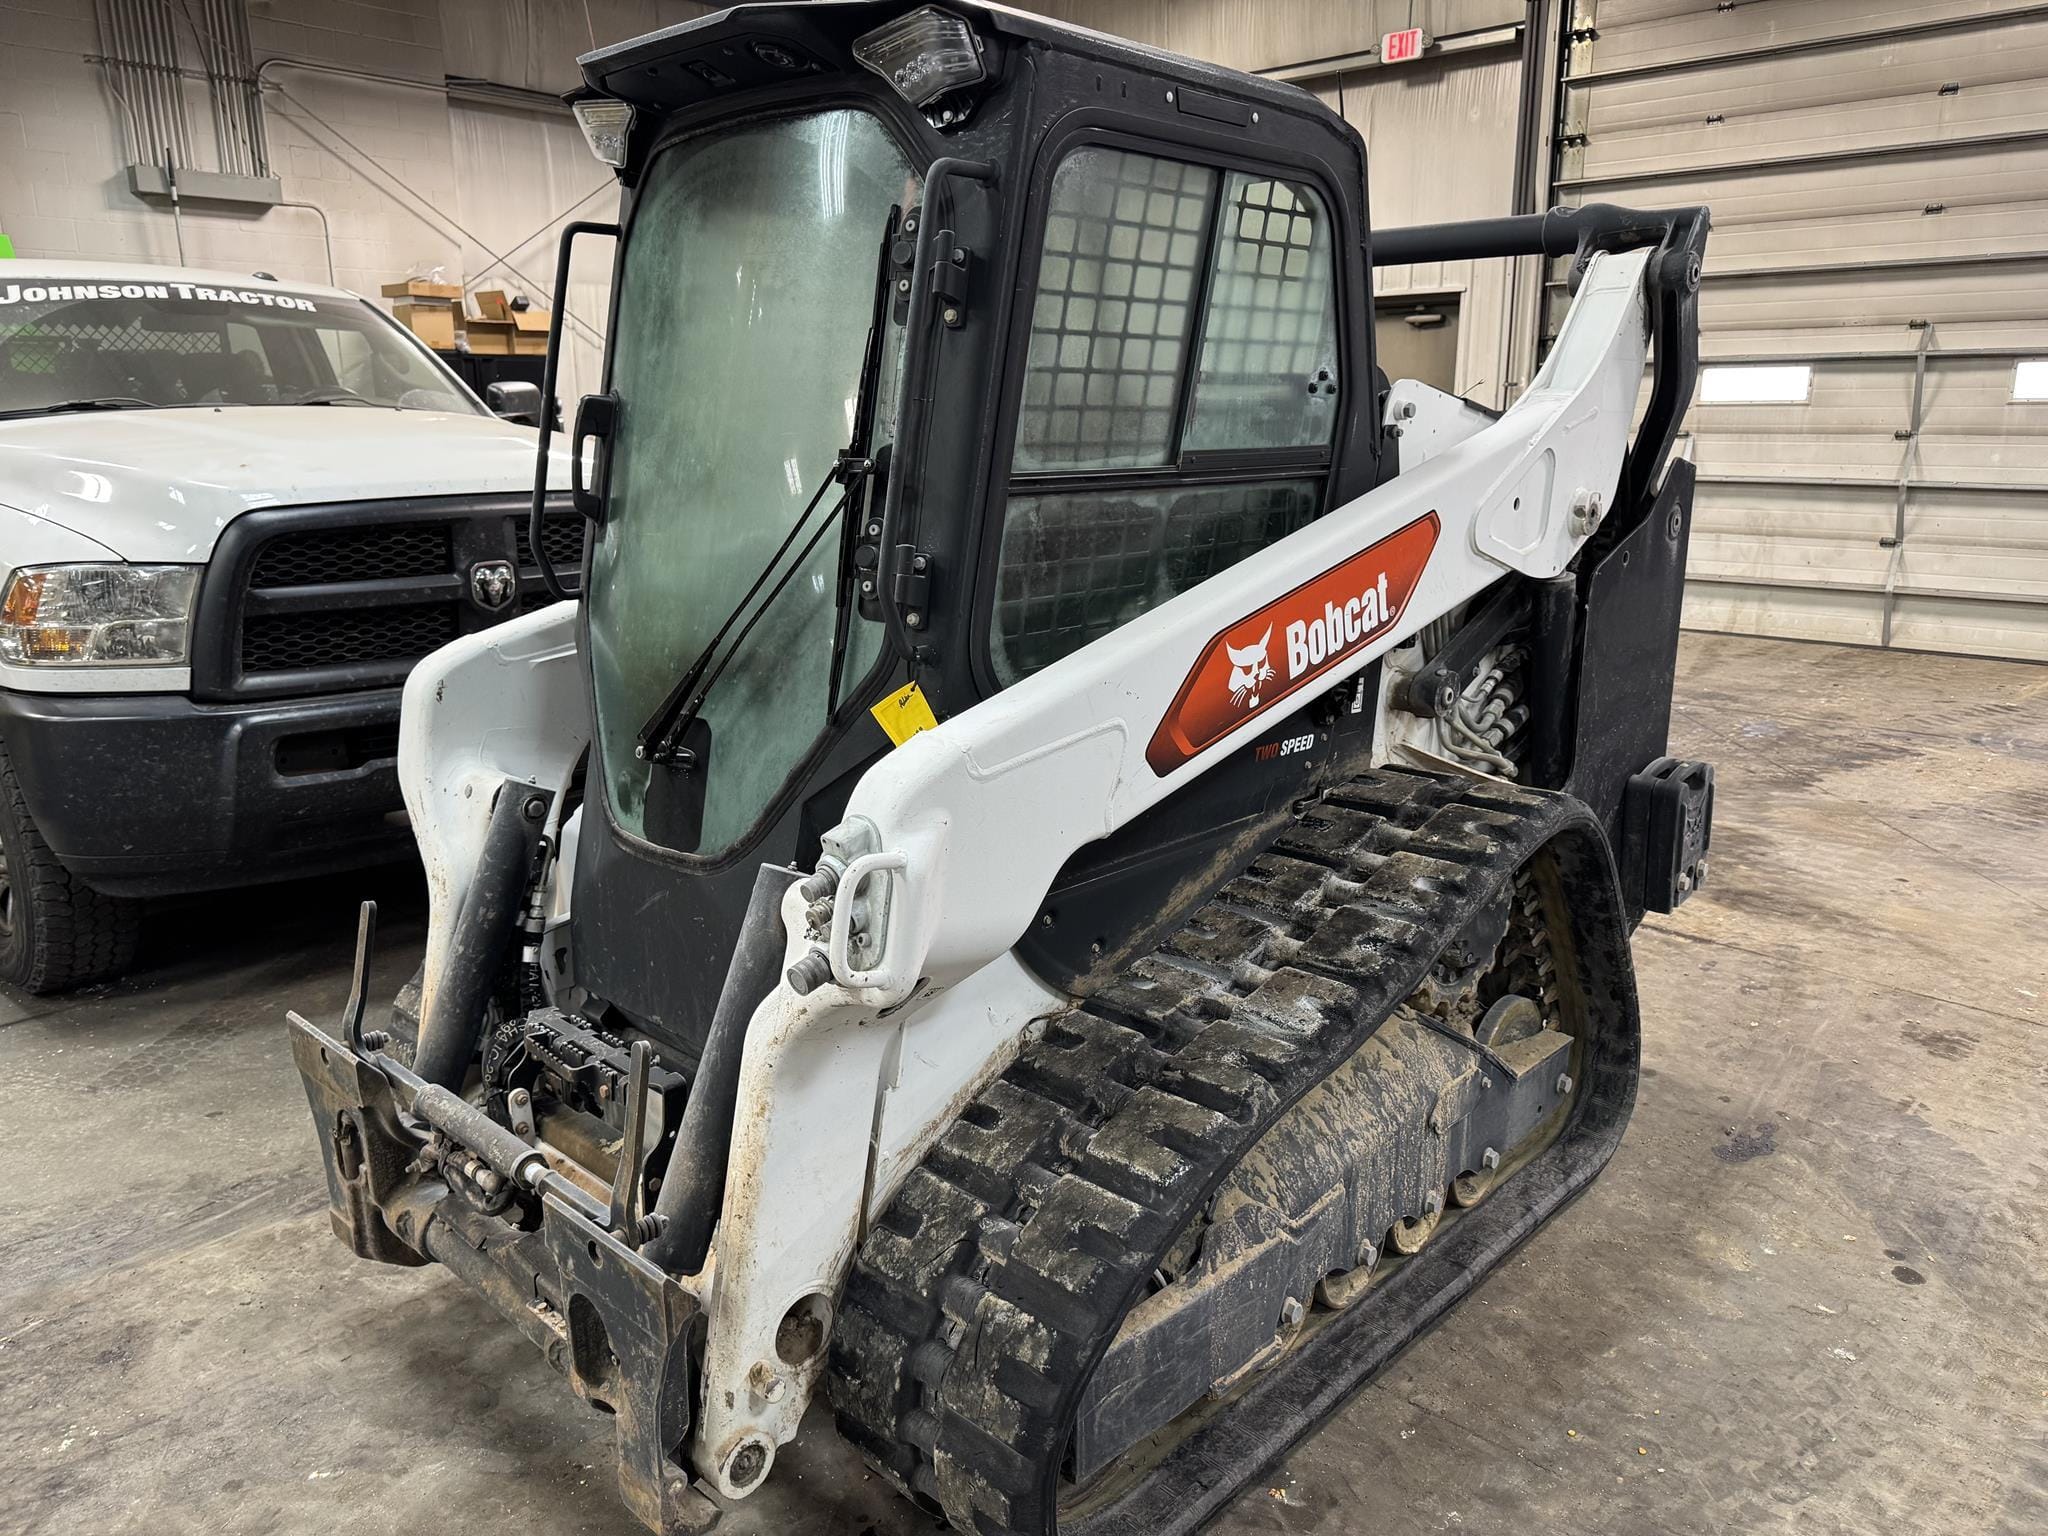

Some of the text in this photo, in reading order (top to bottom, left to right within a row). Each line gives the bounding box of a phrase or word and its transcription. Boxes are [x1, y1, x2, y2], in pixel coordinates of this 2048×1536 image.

[1388, 30, 1418, 60] EXIT
[0, 283, 317, 312] JOHNSON TRACTOR
[1286, 571, 1389, 680] Bobcat
[1254, 734, 1315, 761] TWO SPEED
